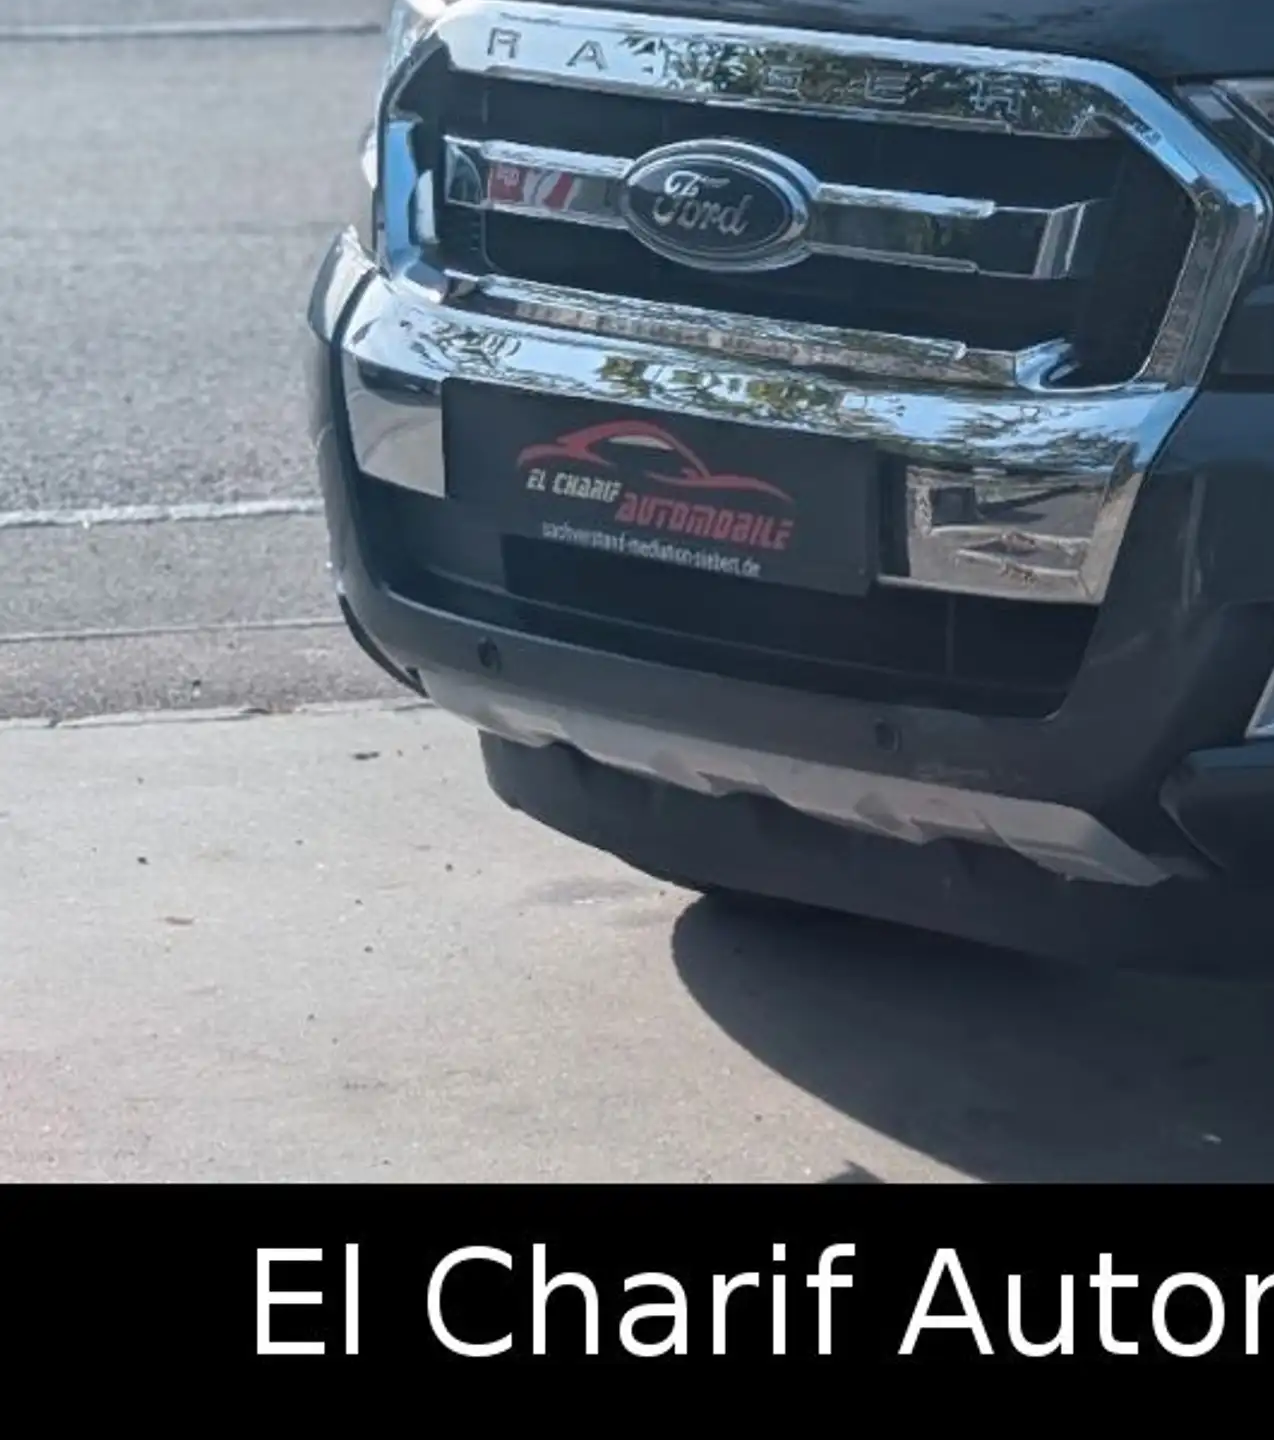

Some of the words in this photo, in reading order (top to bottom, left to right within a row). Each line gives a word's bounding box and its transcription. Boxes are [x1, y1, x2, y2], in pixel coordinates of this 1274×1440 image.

[487, 26, 1020, 118] RAGER
[652, 170, 753, 237] Ford
[526, 467, 547, 491] EL
[552, 471, 622, 503] CHARIF
[614, 491, 794, 550] AUTOMOBILE
